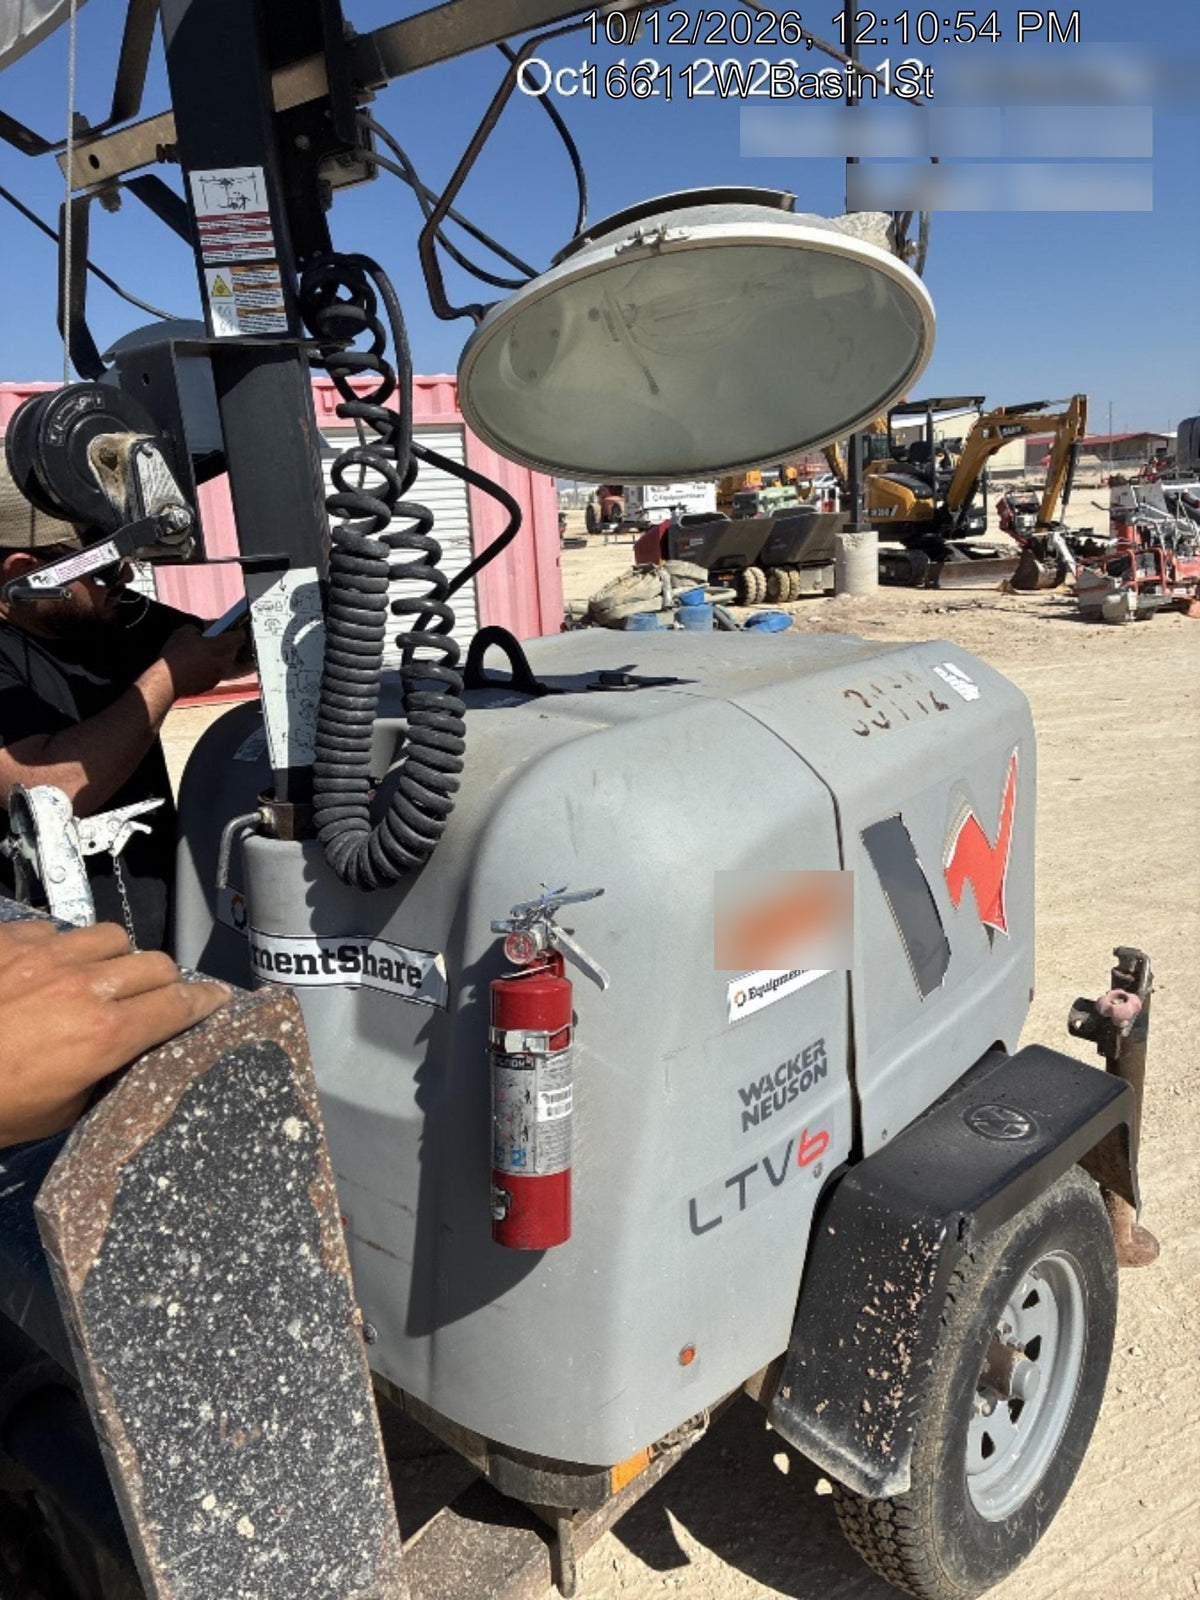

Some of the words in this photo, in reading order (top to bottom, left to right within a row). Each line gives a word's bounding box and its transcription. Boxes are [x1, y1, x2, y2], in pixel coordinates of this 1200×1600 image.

[738, 1037, 827, 1107] WACKER
[741, 1057, 829, 1134] NEUSON
[688, 1127, 831, 1237] LTV6
